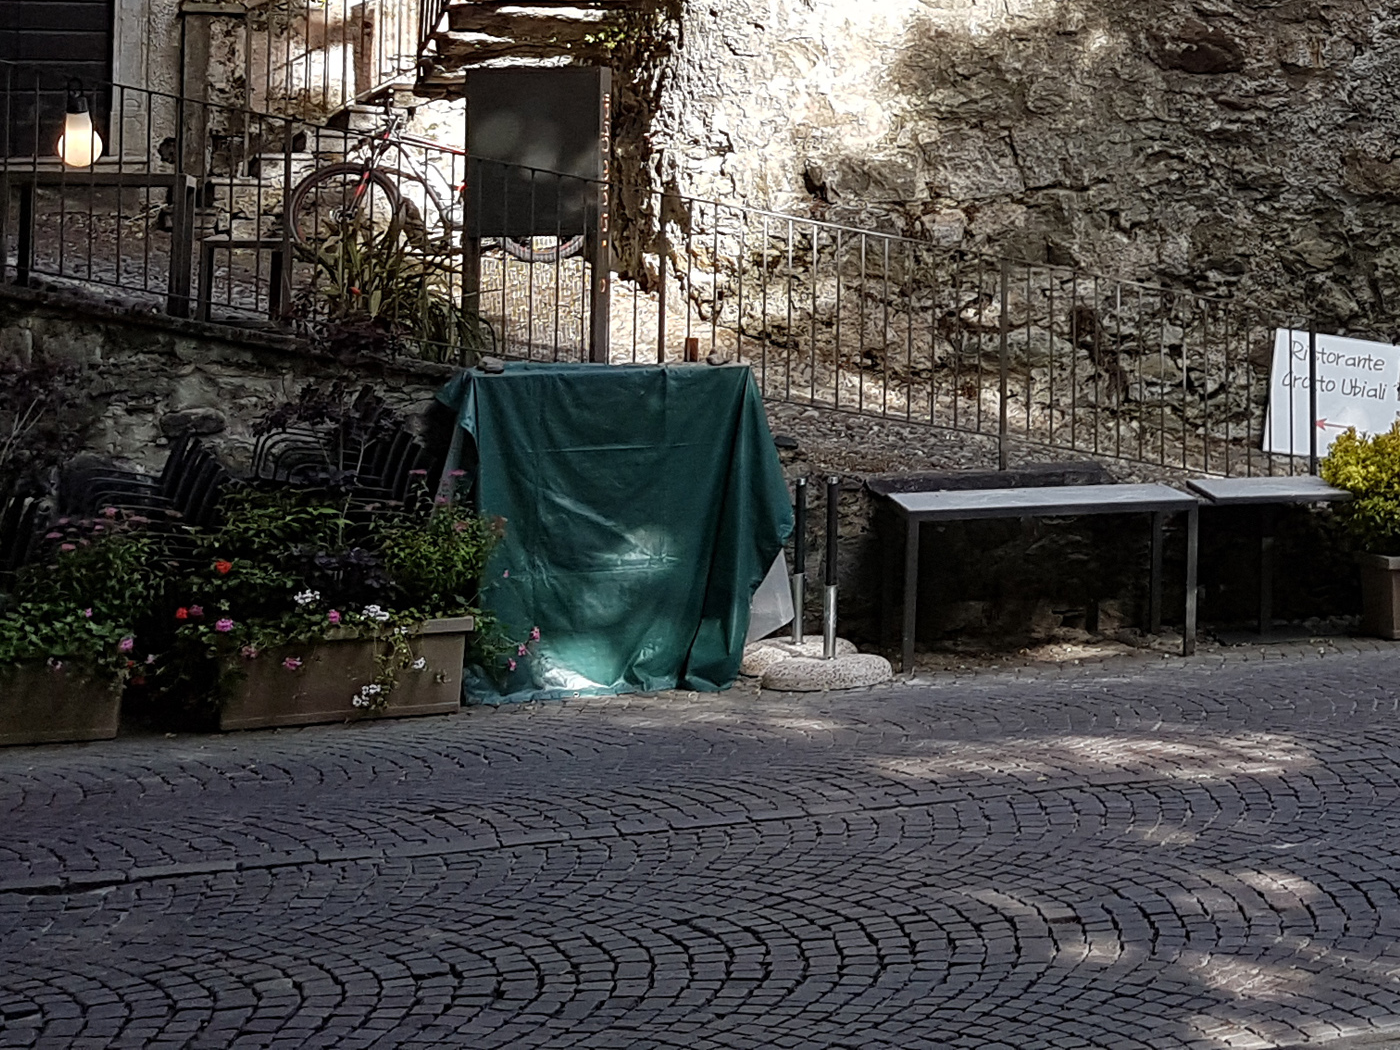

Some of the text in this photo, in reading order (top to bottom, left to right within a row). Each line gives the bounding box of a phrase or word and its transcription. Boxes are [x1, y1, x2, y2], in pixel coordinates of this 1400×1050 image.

[1291, 340, 1385, 371] Ritorante
[1281, 370, 1388, 400] Groto Ubiali
